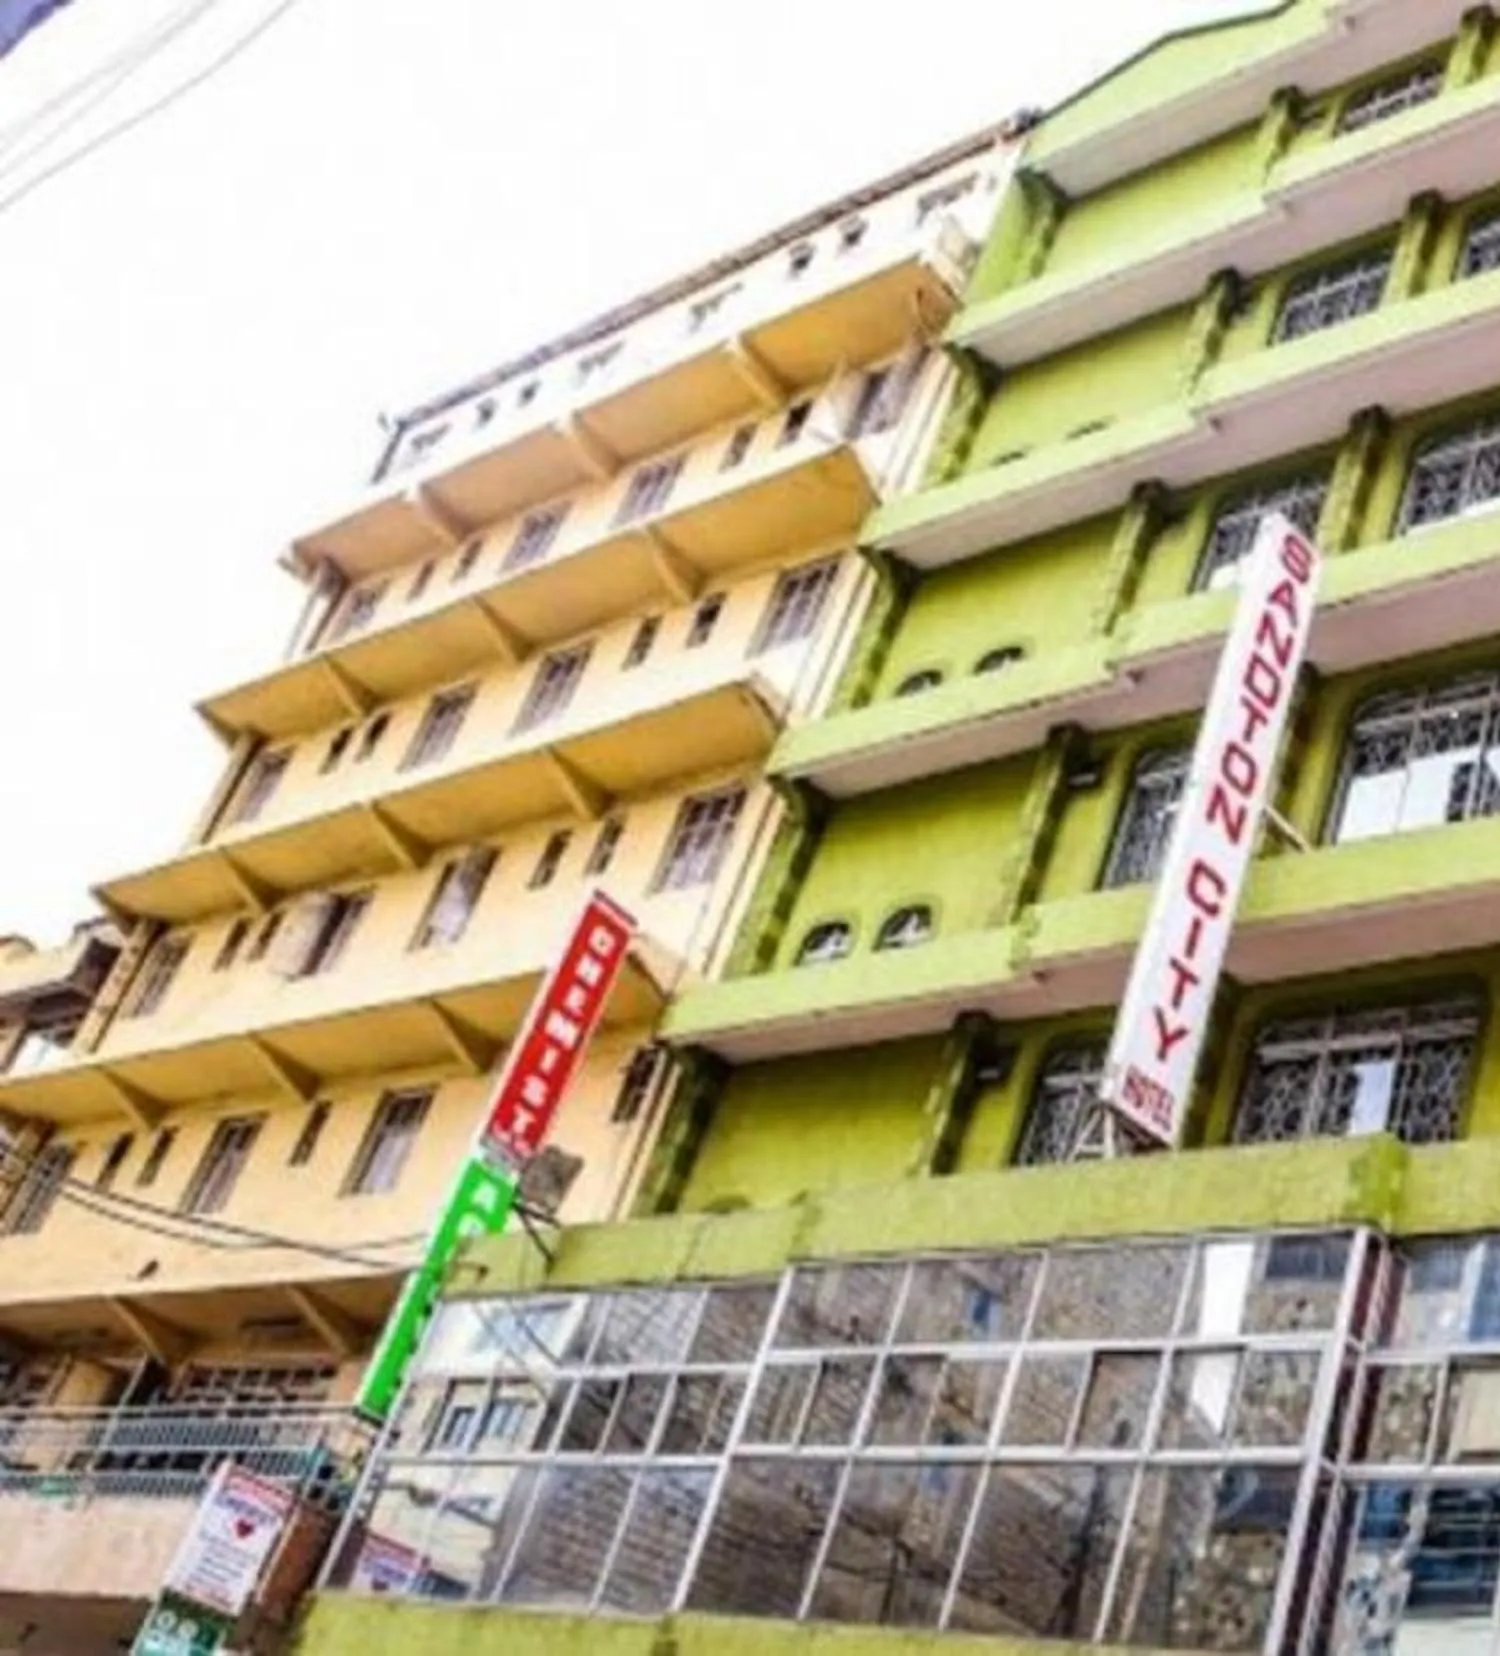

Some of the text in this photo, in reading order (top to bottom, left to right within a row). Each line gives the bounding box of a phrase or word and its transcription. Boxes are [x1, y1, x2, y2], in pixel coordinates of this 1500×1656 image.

[1153, 533, 1313, 1062] SANDTON CITY
[512, 925, 616, 1137] CHEMIST
[1121, 1064, 1176, 1133] HOTEL
